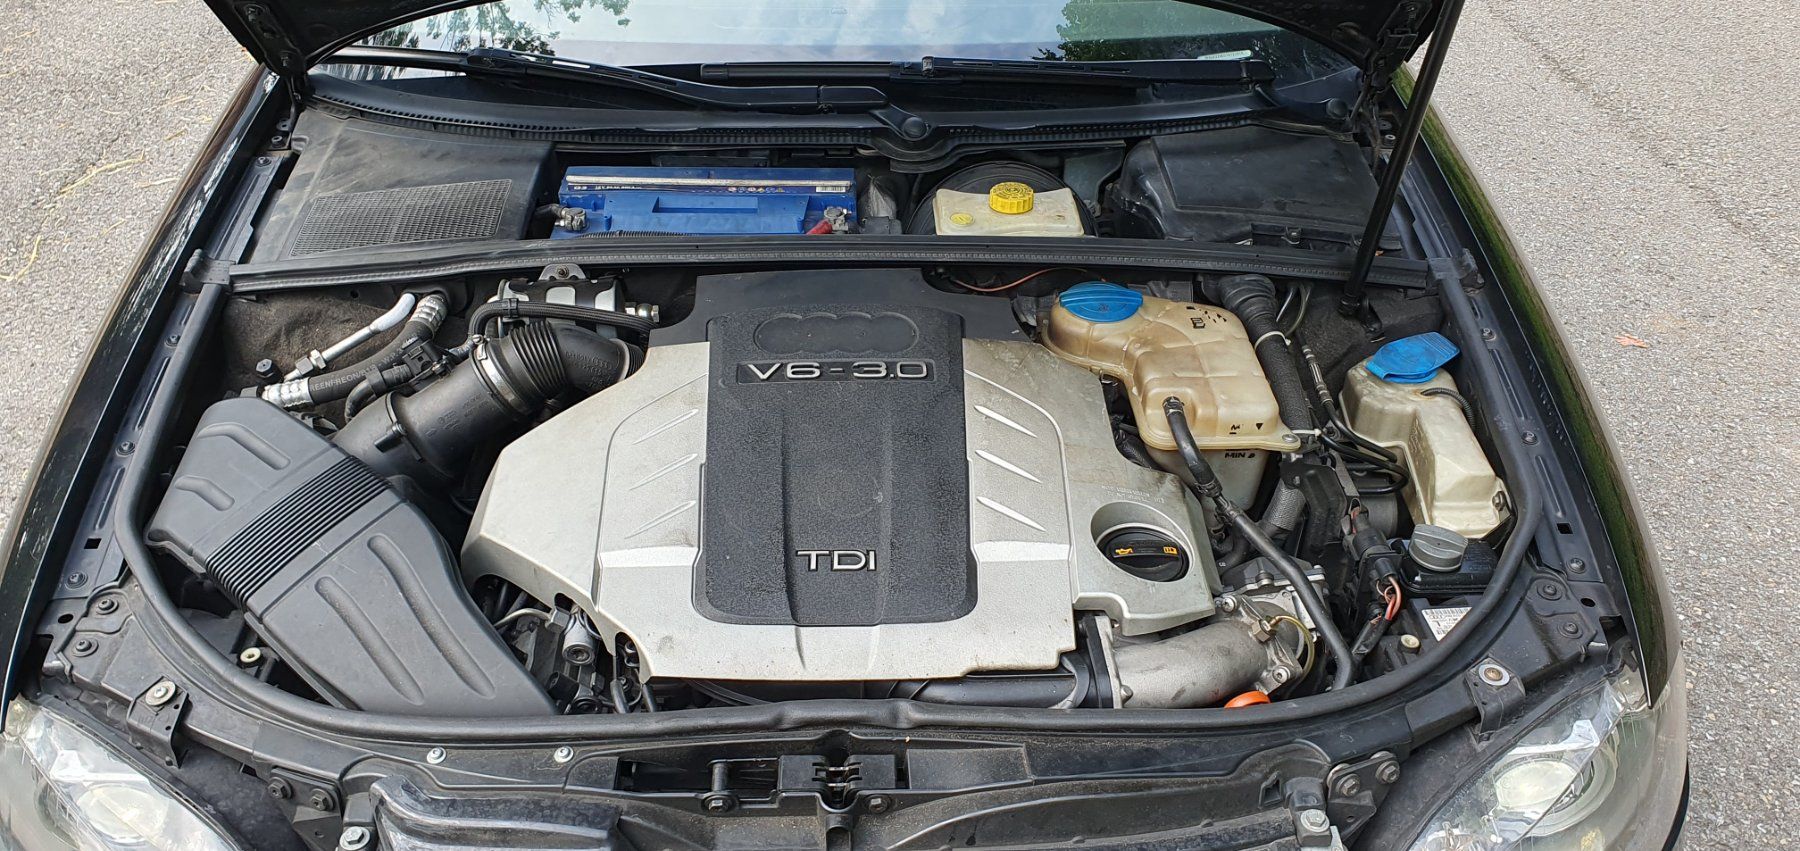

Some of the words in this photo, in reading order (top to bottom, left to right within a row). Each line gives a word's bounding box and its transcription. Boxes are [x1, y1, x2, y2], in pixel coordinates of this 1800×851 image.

[747, 361, 821, 380] V6
[852, 361, 928, 379] 3.0
[797, 550, 876, 570] TDI
